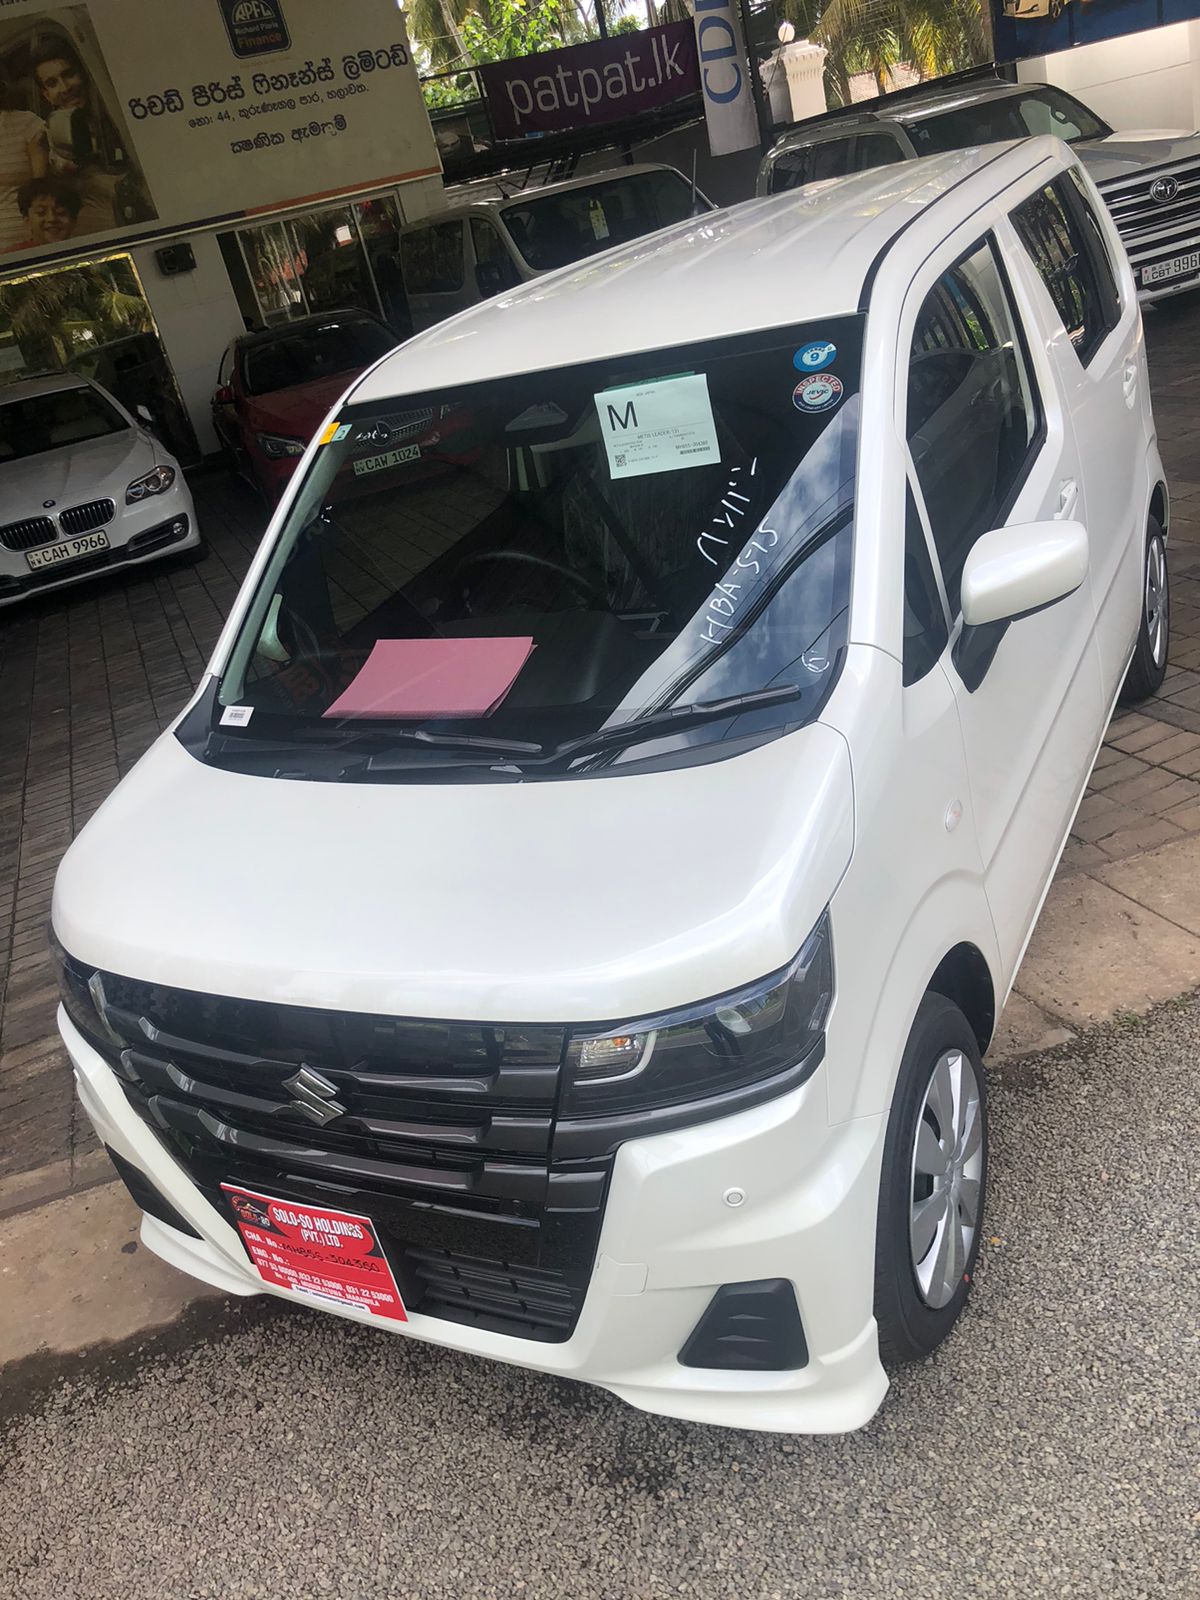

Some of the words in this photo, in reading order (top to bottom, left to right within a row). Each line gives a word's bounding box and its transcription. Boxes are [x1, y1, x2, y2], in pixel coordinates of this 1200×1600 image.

[695, 0, 742, 104] CD
[505, 34, 685, 125] patpat.lk
[1151, 267, 1172, 280] CBT
[1173, 252, 1200, 273] 996
[795, 375, 841, 395] INSPECTED
[607, 400, 639, 431] M
[391, 445, 419, 464] 1024
[41, 544, 70, 563] CAH
[72, 534, 106, 554] 9966
[272, 1206, 314, 1230] SOLO-SO
[313, 1215, 364, 1240] HOLDINGS
[301, 1227, 325, 1246] (PVT.)
[325, 1233, 344, 1248] LTD.
[251, 1246, 271, 1260] ENG.
